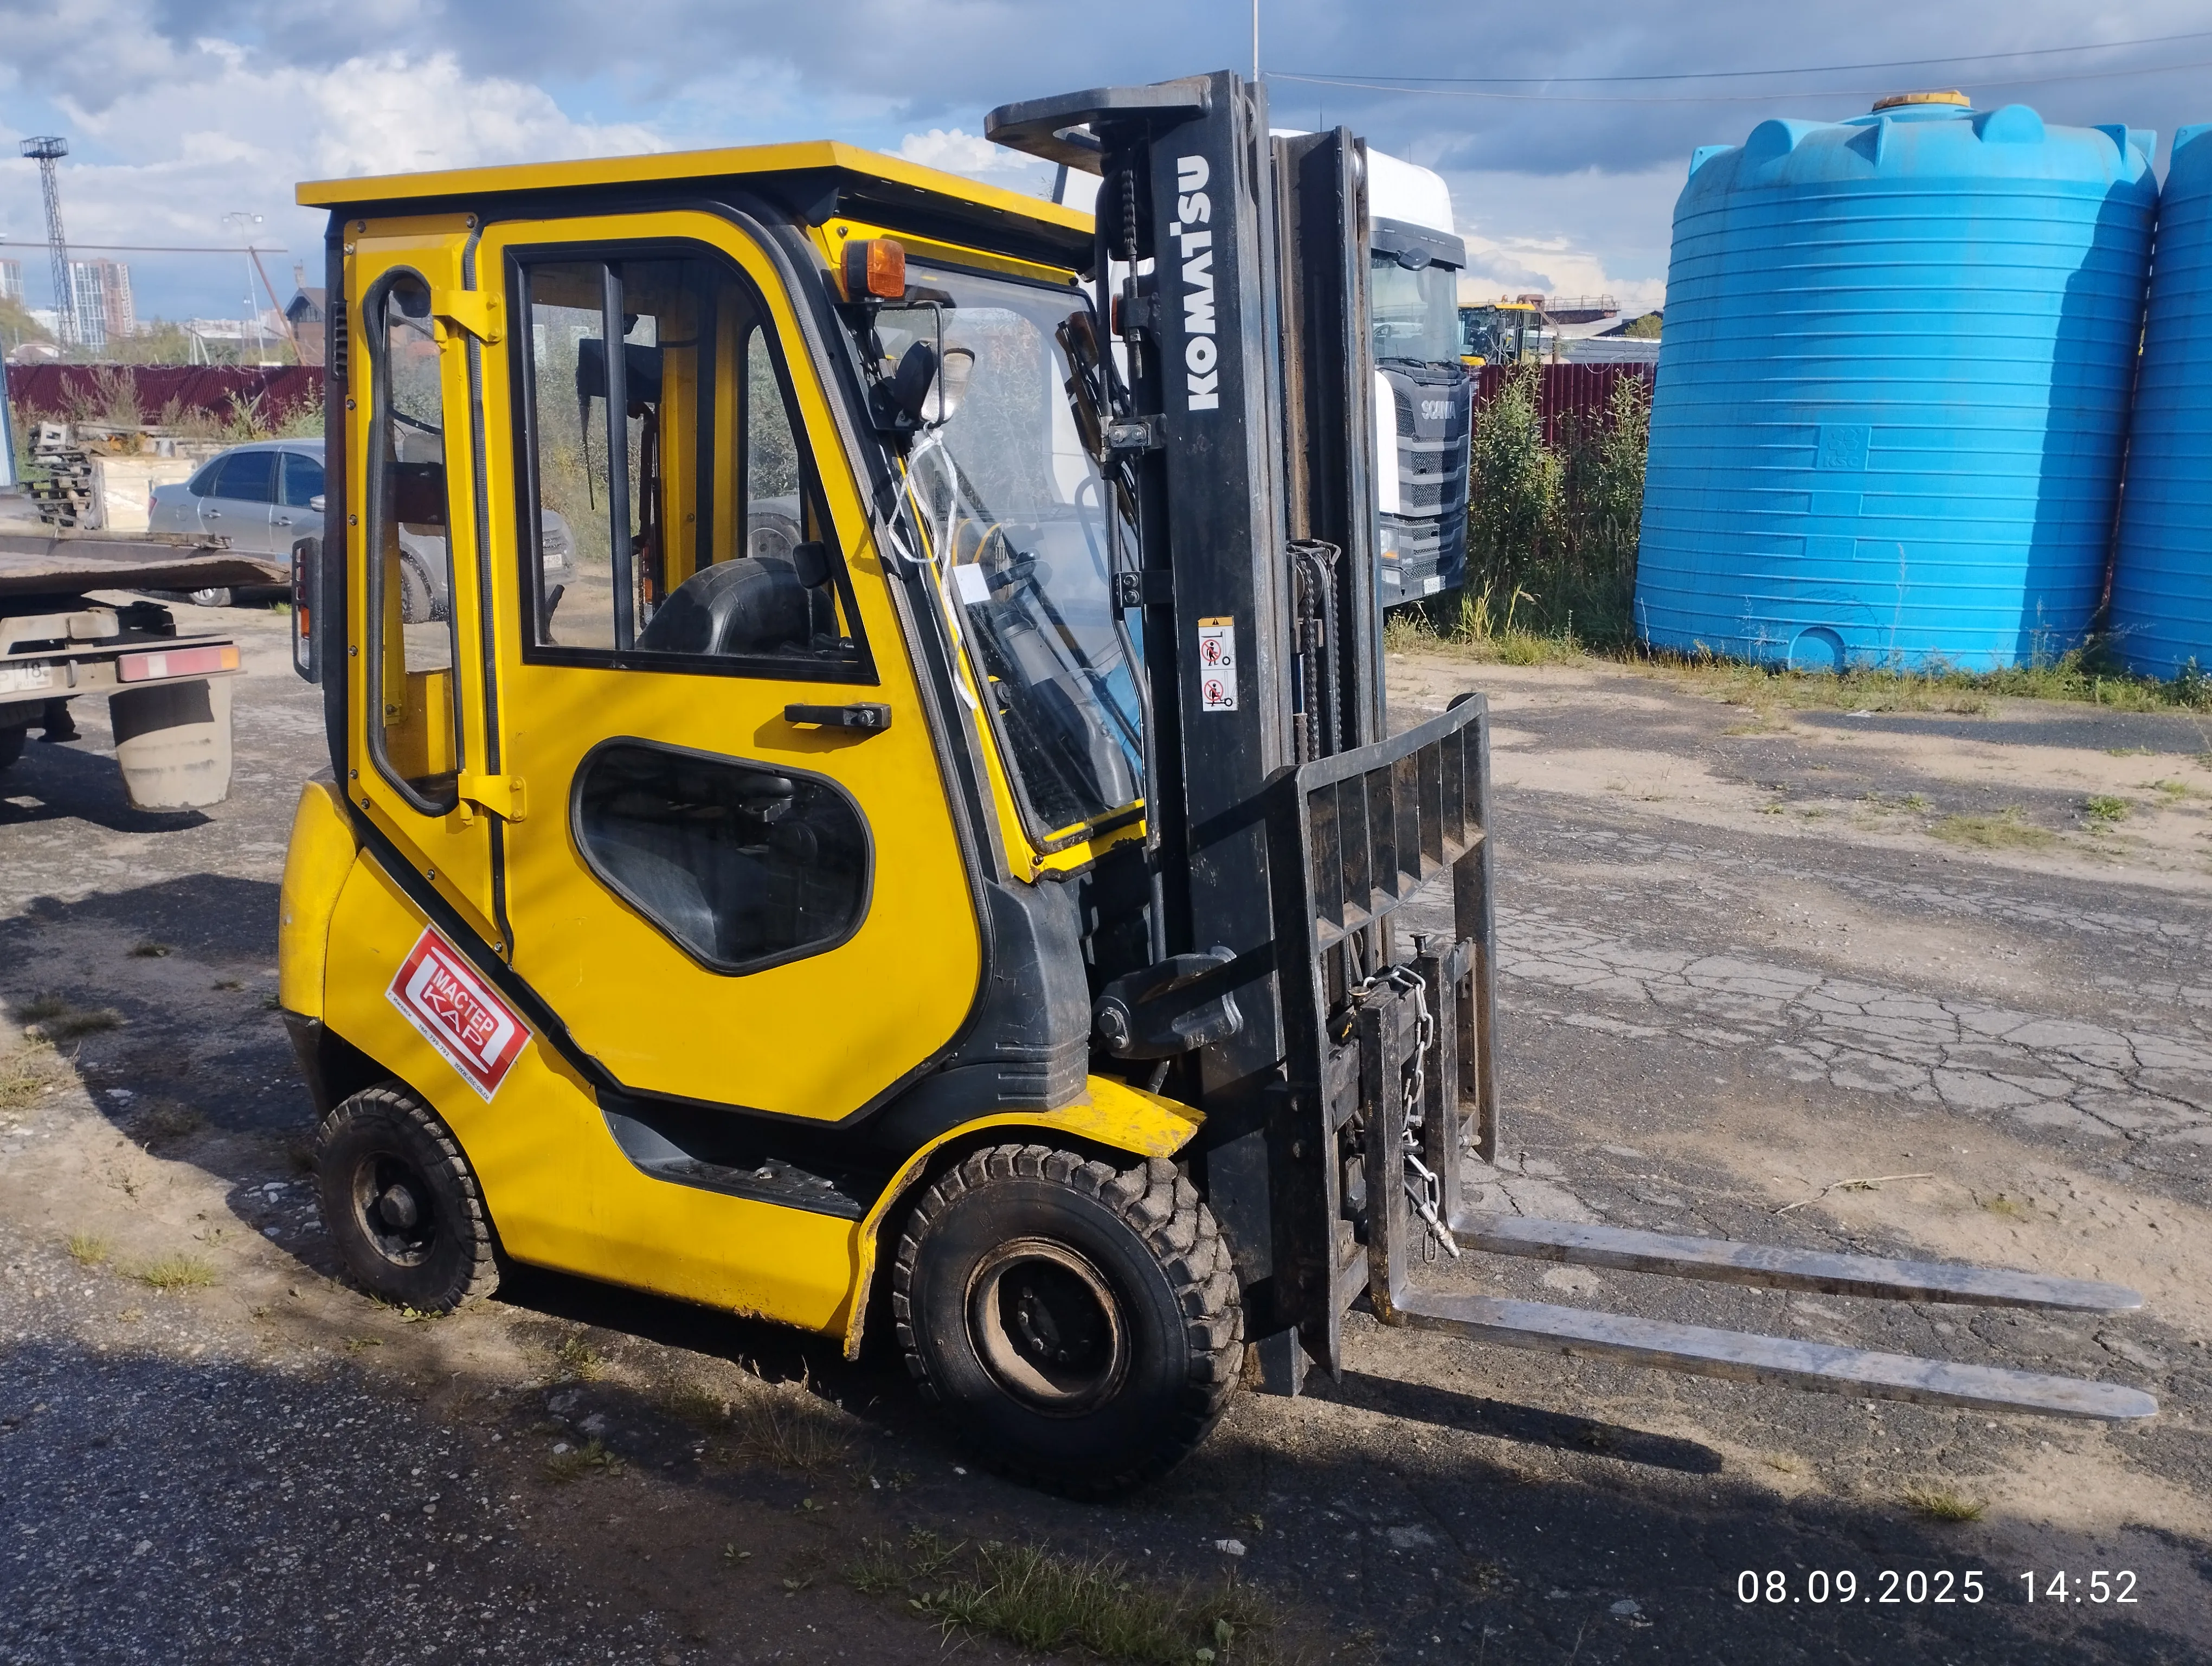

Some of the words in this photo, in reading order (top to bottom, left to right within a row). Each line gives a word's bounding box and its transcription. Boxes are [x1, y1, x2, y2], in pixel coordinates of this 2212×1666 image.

[1170, 156, 1218, 411] KOMATSU
[1422, 400, 1456, 420] SCANIA
[22, 662, 42, 679] 18
[423, 985, 483, 1046] КАР
[433, 968, 494, 1033] МАСТЕР
[393, 997, 412, 1018] Ижевск
[454, 1062, 489, 1100] www.mc-co.ru
